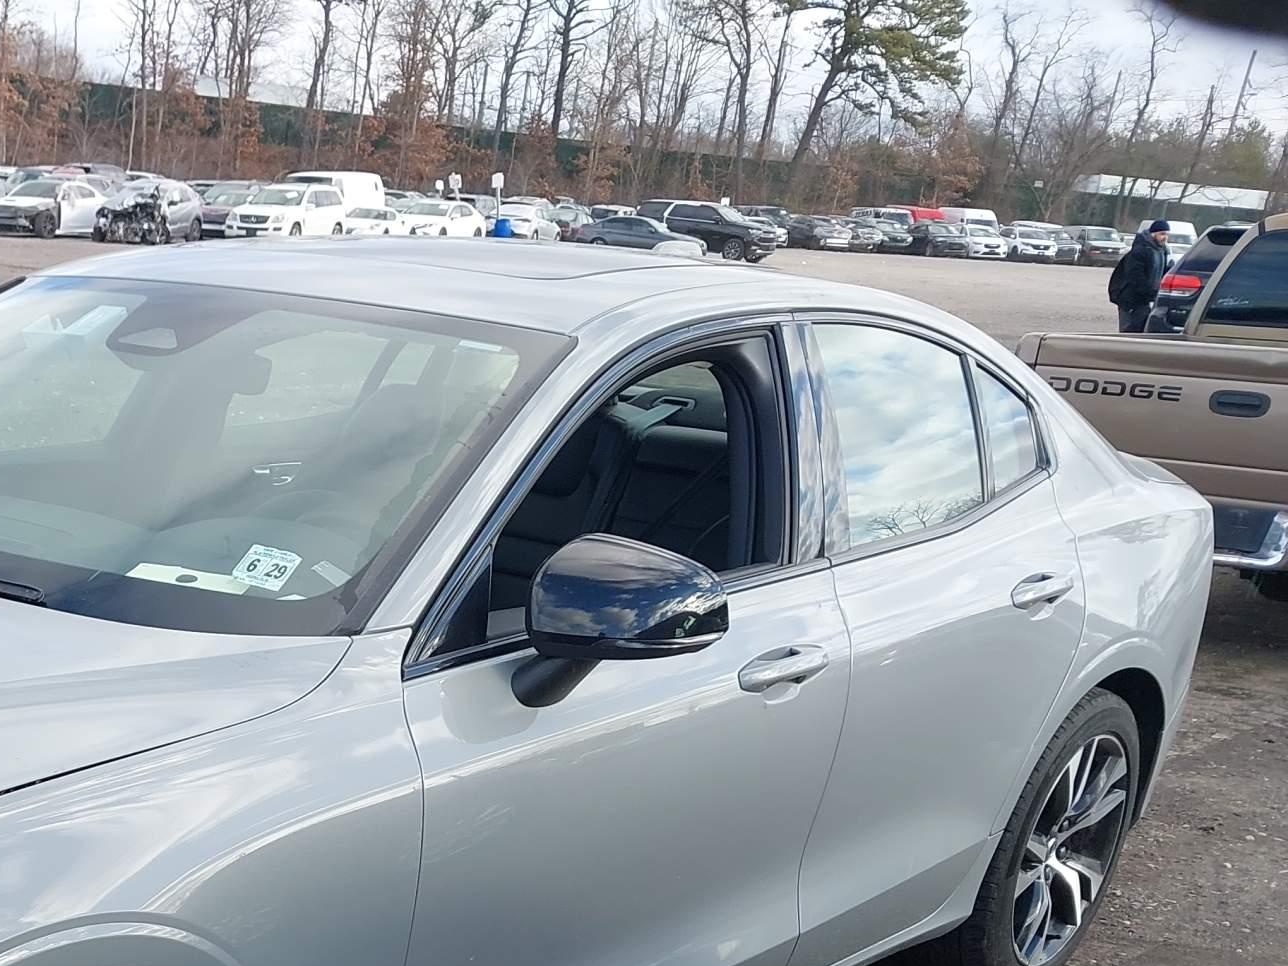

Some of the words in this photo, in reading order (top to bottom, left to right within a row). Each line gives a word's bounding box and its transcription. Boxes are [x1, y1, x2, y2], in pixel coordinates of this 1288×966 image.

[1048, 376, 1183, 402] DODGE
[246, 558, 261, 573] 6
[263, 563, 288, 579] 29
